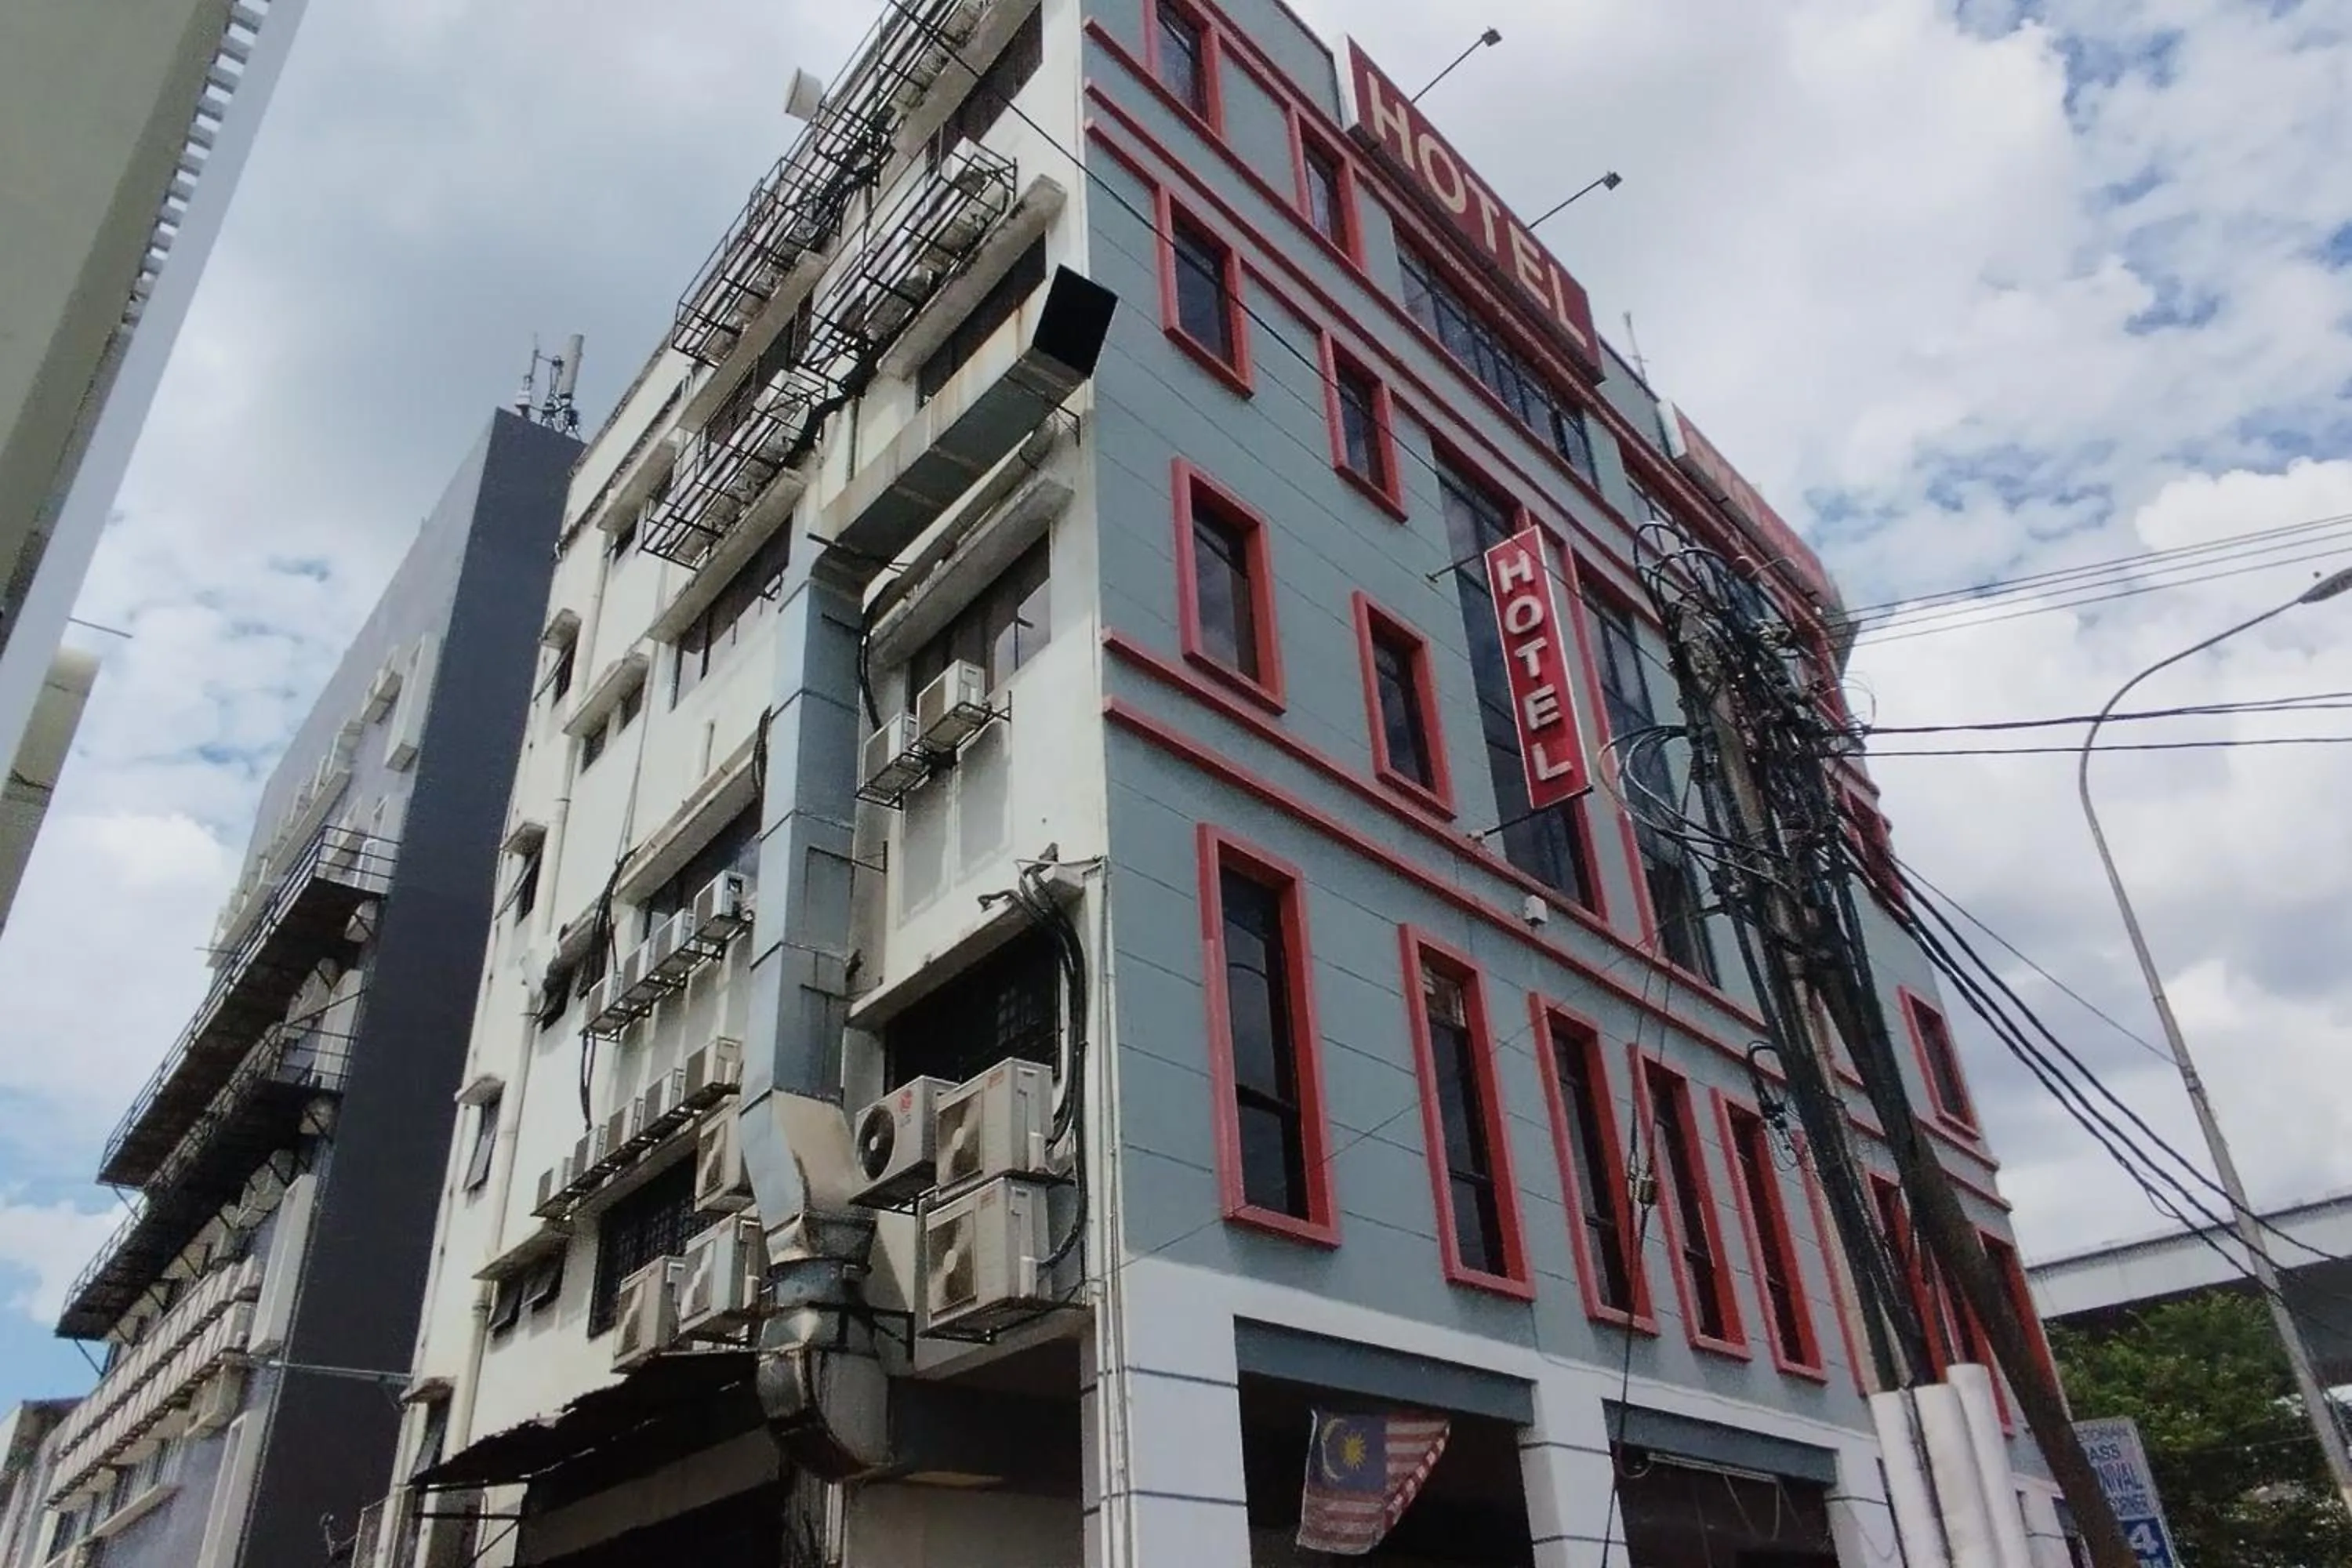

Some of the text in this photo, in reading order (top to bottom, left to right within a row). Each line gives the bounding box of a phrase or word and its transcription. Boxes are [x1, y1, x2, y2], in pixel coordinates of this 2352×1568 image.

[1367, 71, 1587, 348] HOTEL
[1497, 550, 1573, 781] HOTEL
[2089, 1443, 2122, 1460] ASS
